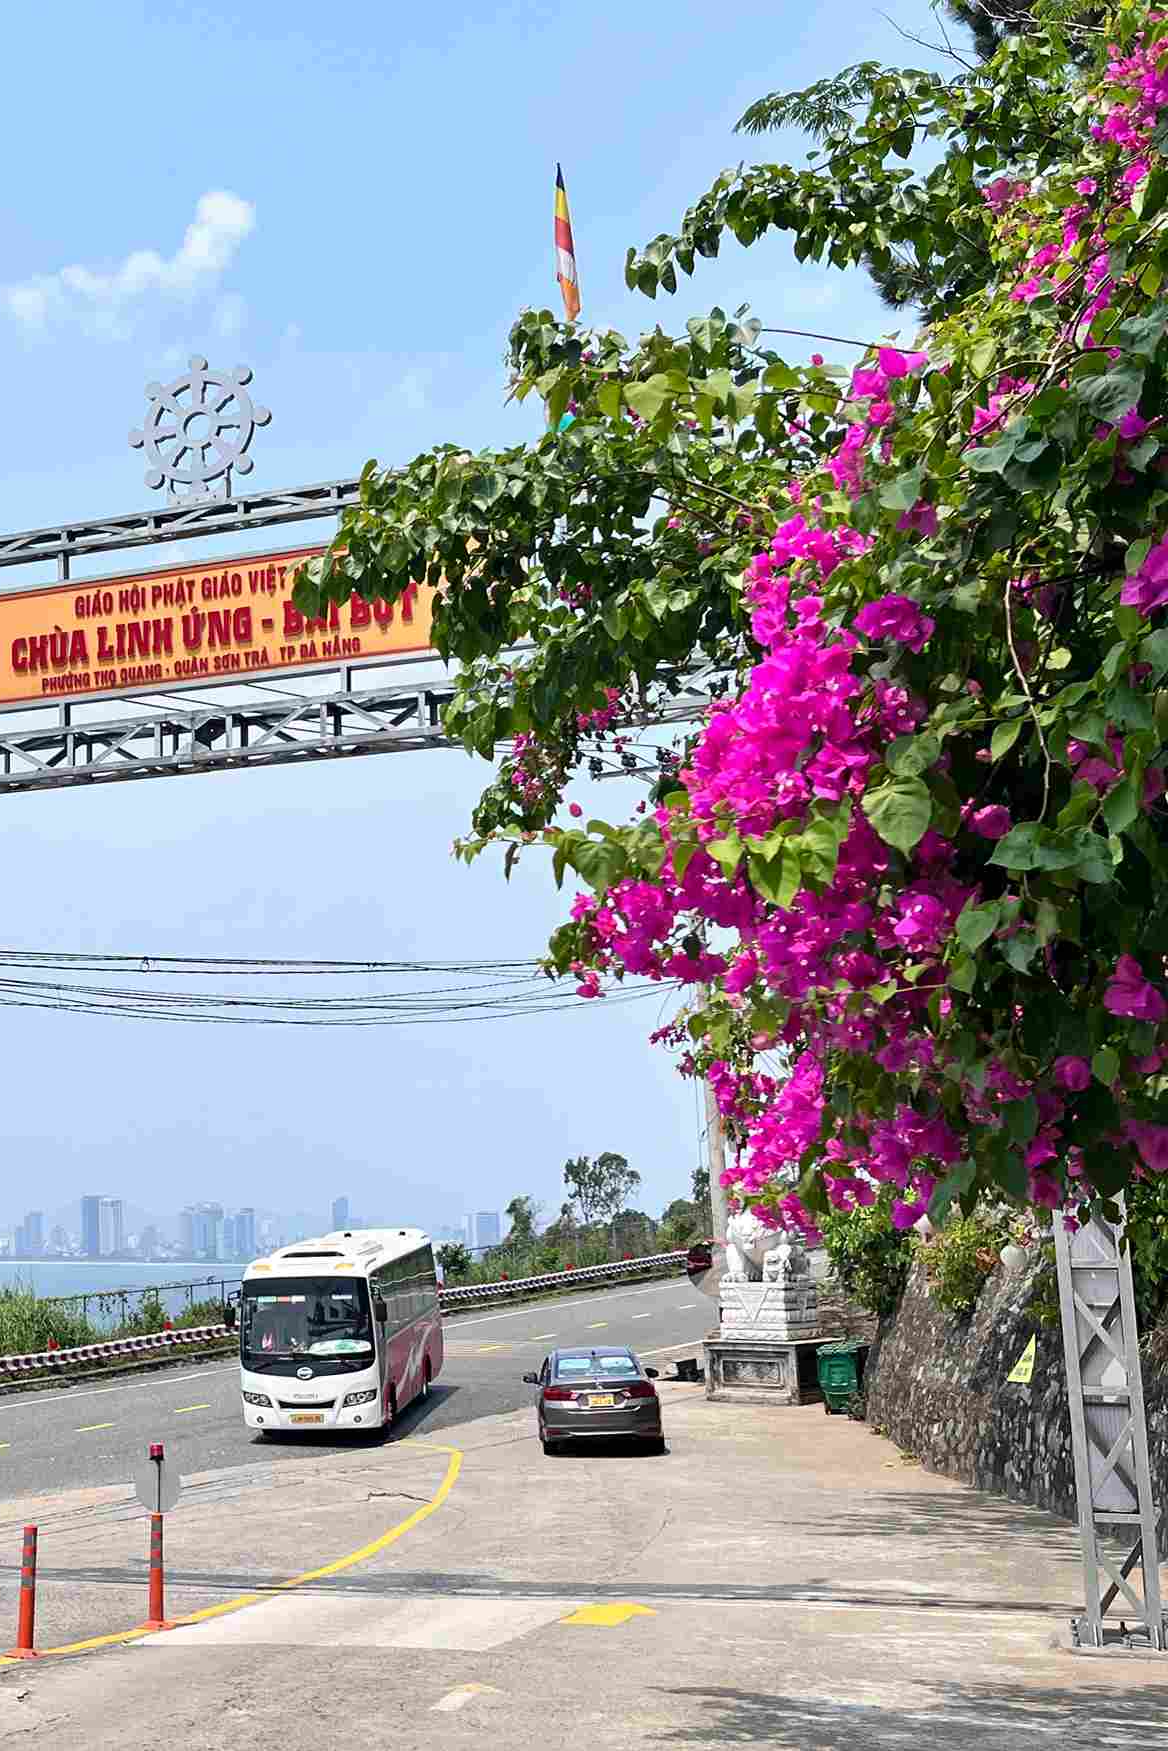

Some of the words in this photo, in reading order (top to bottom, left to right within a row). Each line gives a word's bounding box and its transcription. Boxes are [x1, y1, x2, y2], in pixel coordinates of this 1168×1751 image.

[75, 589, 113, 619] GIÁO
[118, 583, 146, 616] HỘI
[152, 577, 195, 610] PHẬT
[201, 570, 242, 601] GIÁO
[248, 564, 288, 597] VIỆT
[11, 625, 89, 673] CHÙA
[97, 617, 173, 660] LINH
[42, 671, 90, 692] PHƯỜNG
[94, 668, 116, 687] THỌ
[119, 663, 162, 686] QUANG
[214, 653, 239, 672] SƠN
